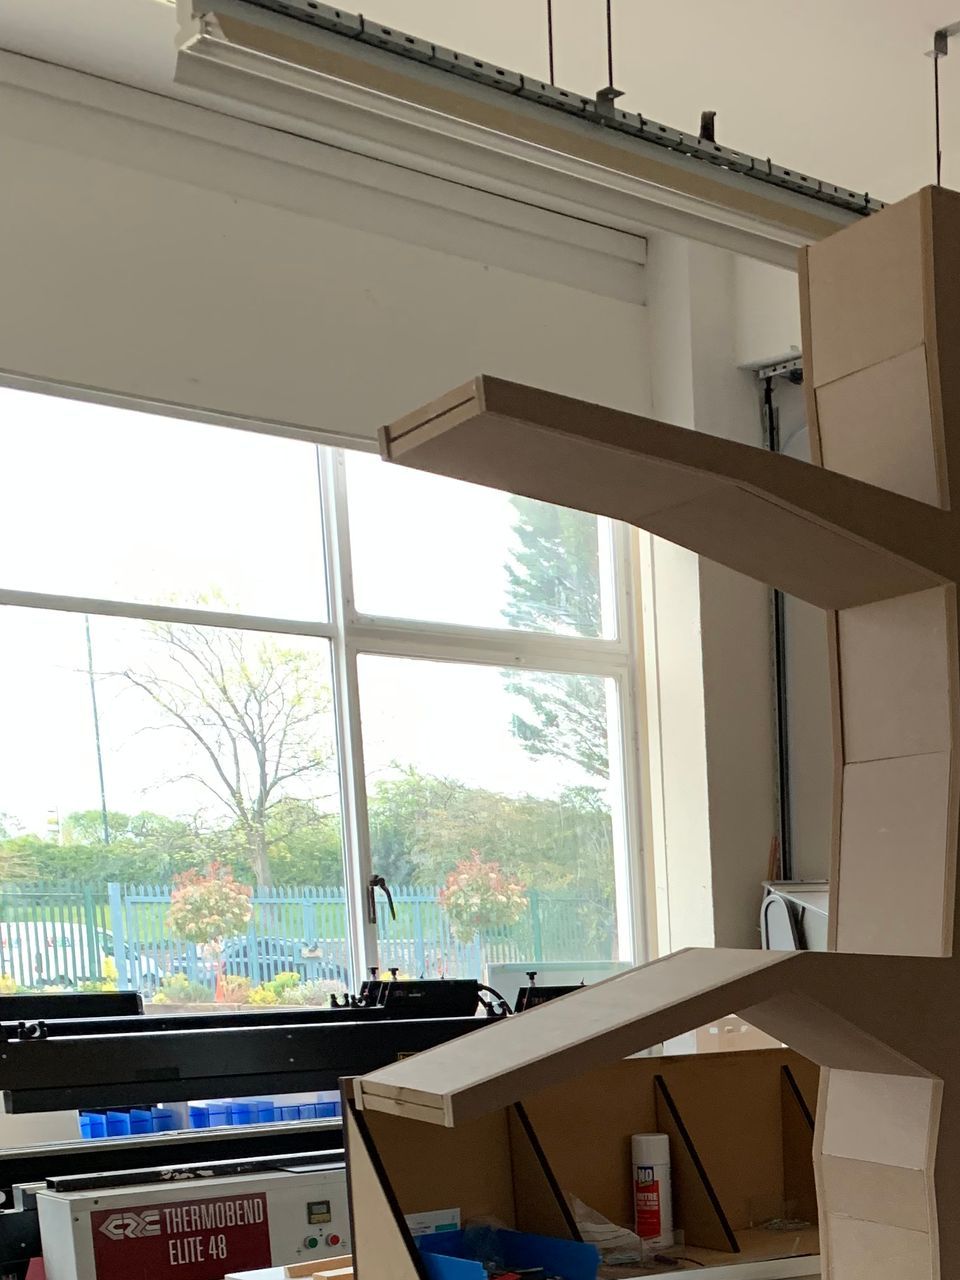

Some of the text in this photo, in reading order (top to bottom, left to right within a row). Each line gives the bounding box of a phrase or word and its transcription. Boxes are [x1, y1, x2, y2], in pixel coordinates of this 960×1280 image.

[164, 1199, 264, 1234] THERMOBEND
[168, 1234, 227, 1266] ELITE 48
